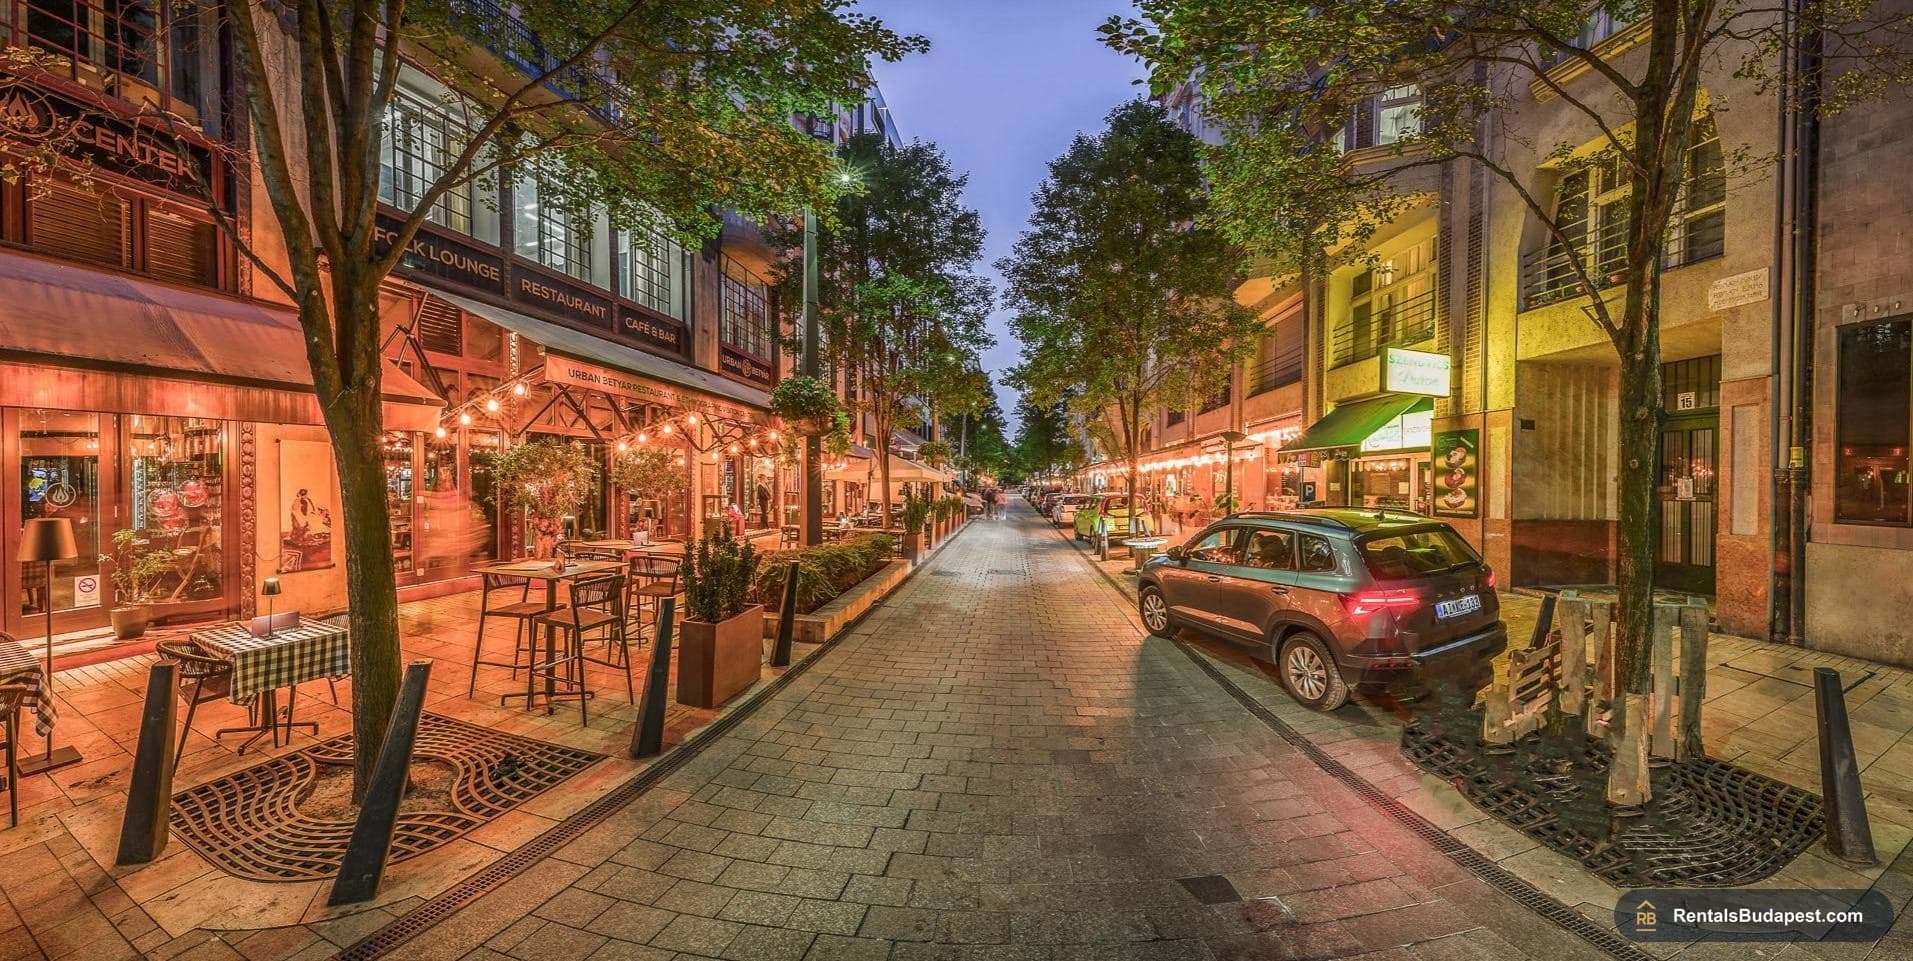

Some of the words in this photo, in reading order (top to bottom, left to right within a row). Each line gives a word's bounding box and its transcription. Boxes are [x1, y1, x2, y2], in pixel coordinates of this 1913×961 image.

[429, 245, 500, 281] LOUNGE
[521, 279, 606, 319] RESTAURANT
[625, 317, 650, 335] CAFÉ
[658, 329, 677, 344] BAR
[722, 354, 742, 368] URBAN
[568, 368, 601, 384] URBAN
[1681, 398, 1692, 408] 15
[1305, 484, 1314, 497] P
